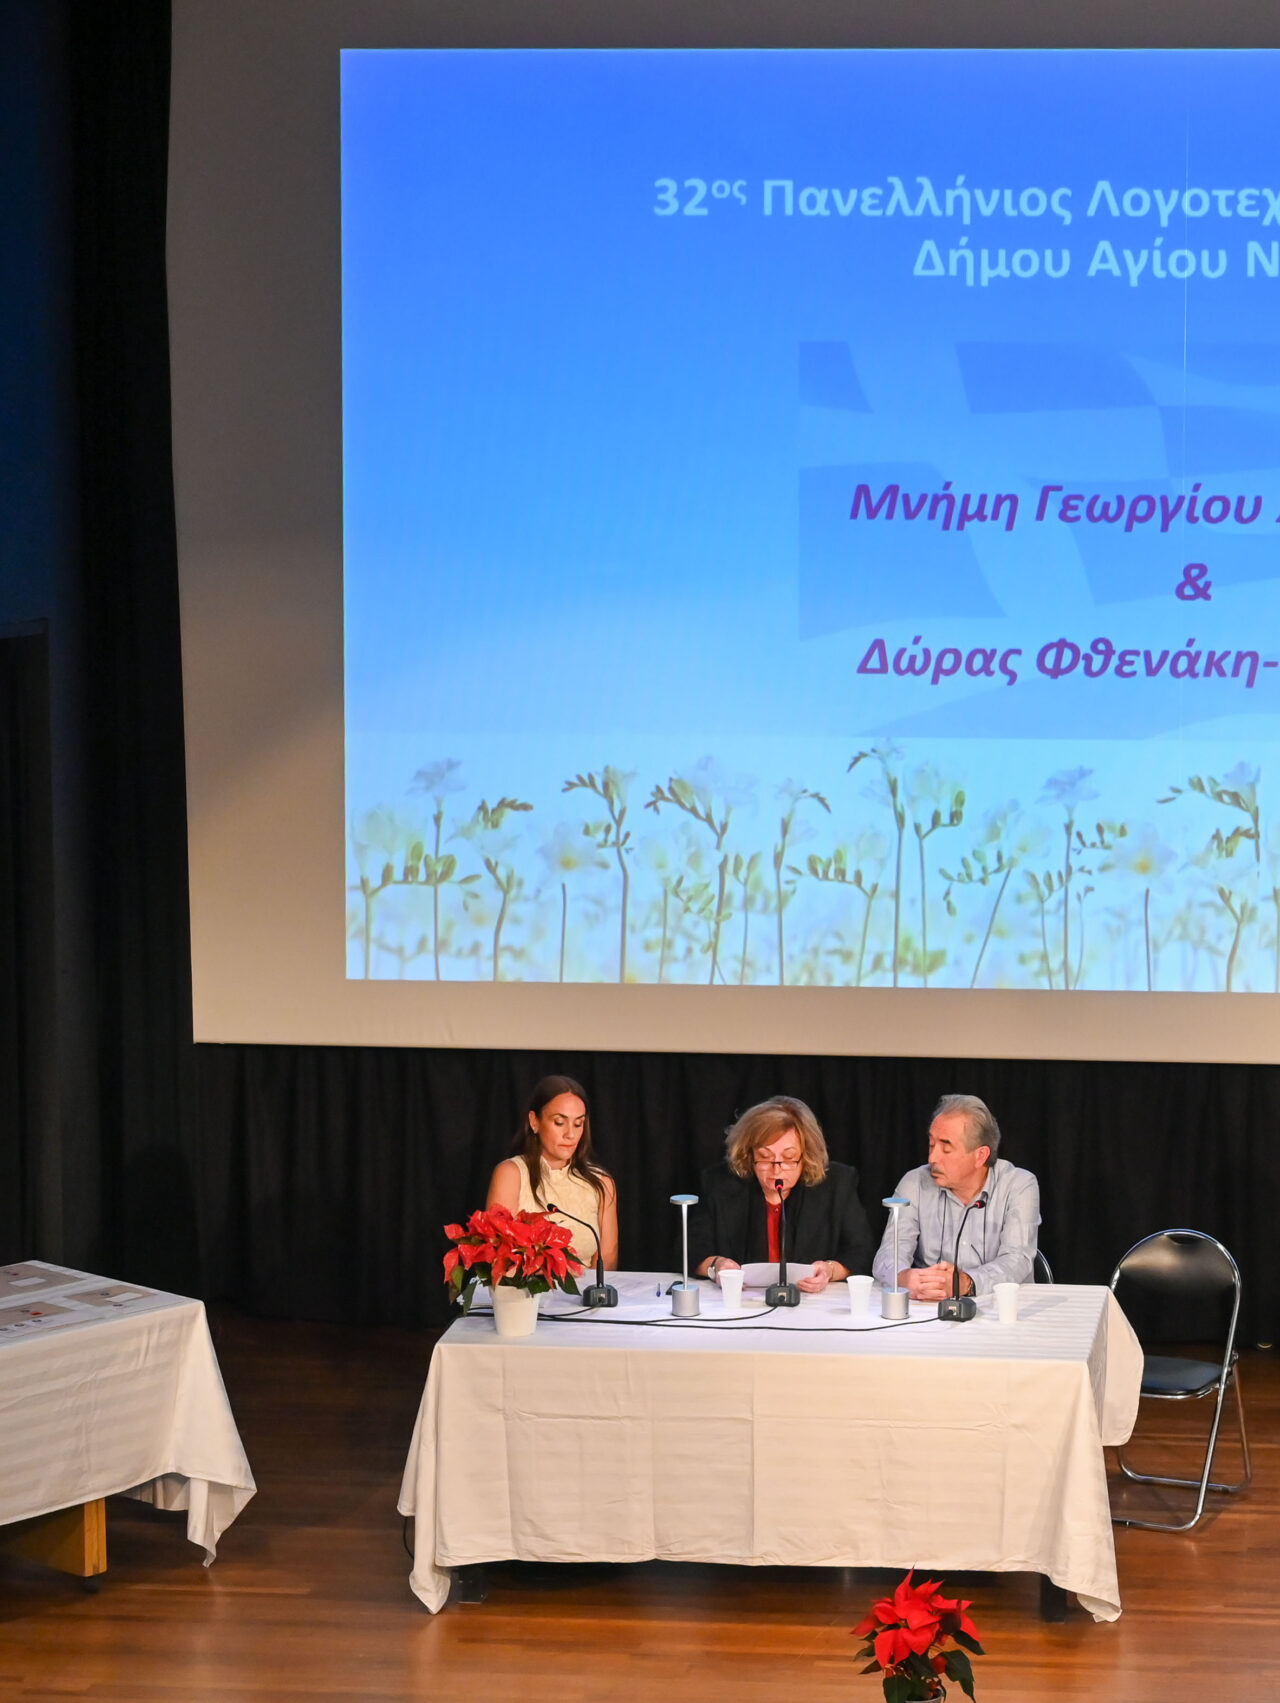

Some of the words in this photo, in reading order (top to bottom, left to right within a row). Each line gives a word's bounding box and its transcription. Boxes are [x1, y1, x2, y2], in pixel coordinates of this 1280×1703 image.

[763, 175, 1072, 226] Πανελλήνιος
[913, 237, 1071, 287] Δήμου
[1087, 237, 1227, 287] Αγίου
[849, 481, 1019, 531] Μνήμη
[1035, 483, 1262, 533] Γεωργίου
[1175, 563, 1212, 601] &
[857, 635, 1022, 686] Δώρας
[1036, 637, 1279, 688] Φθενάκη-
